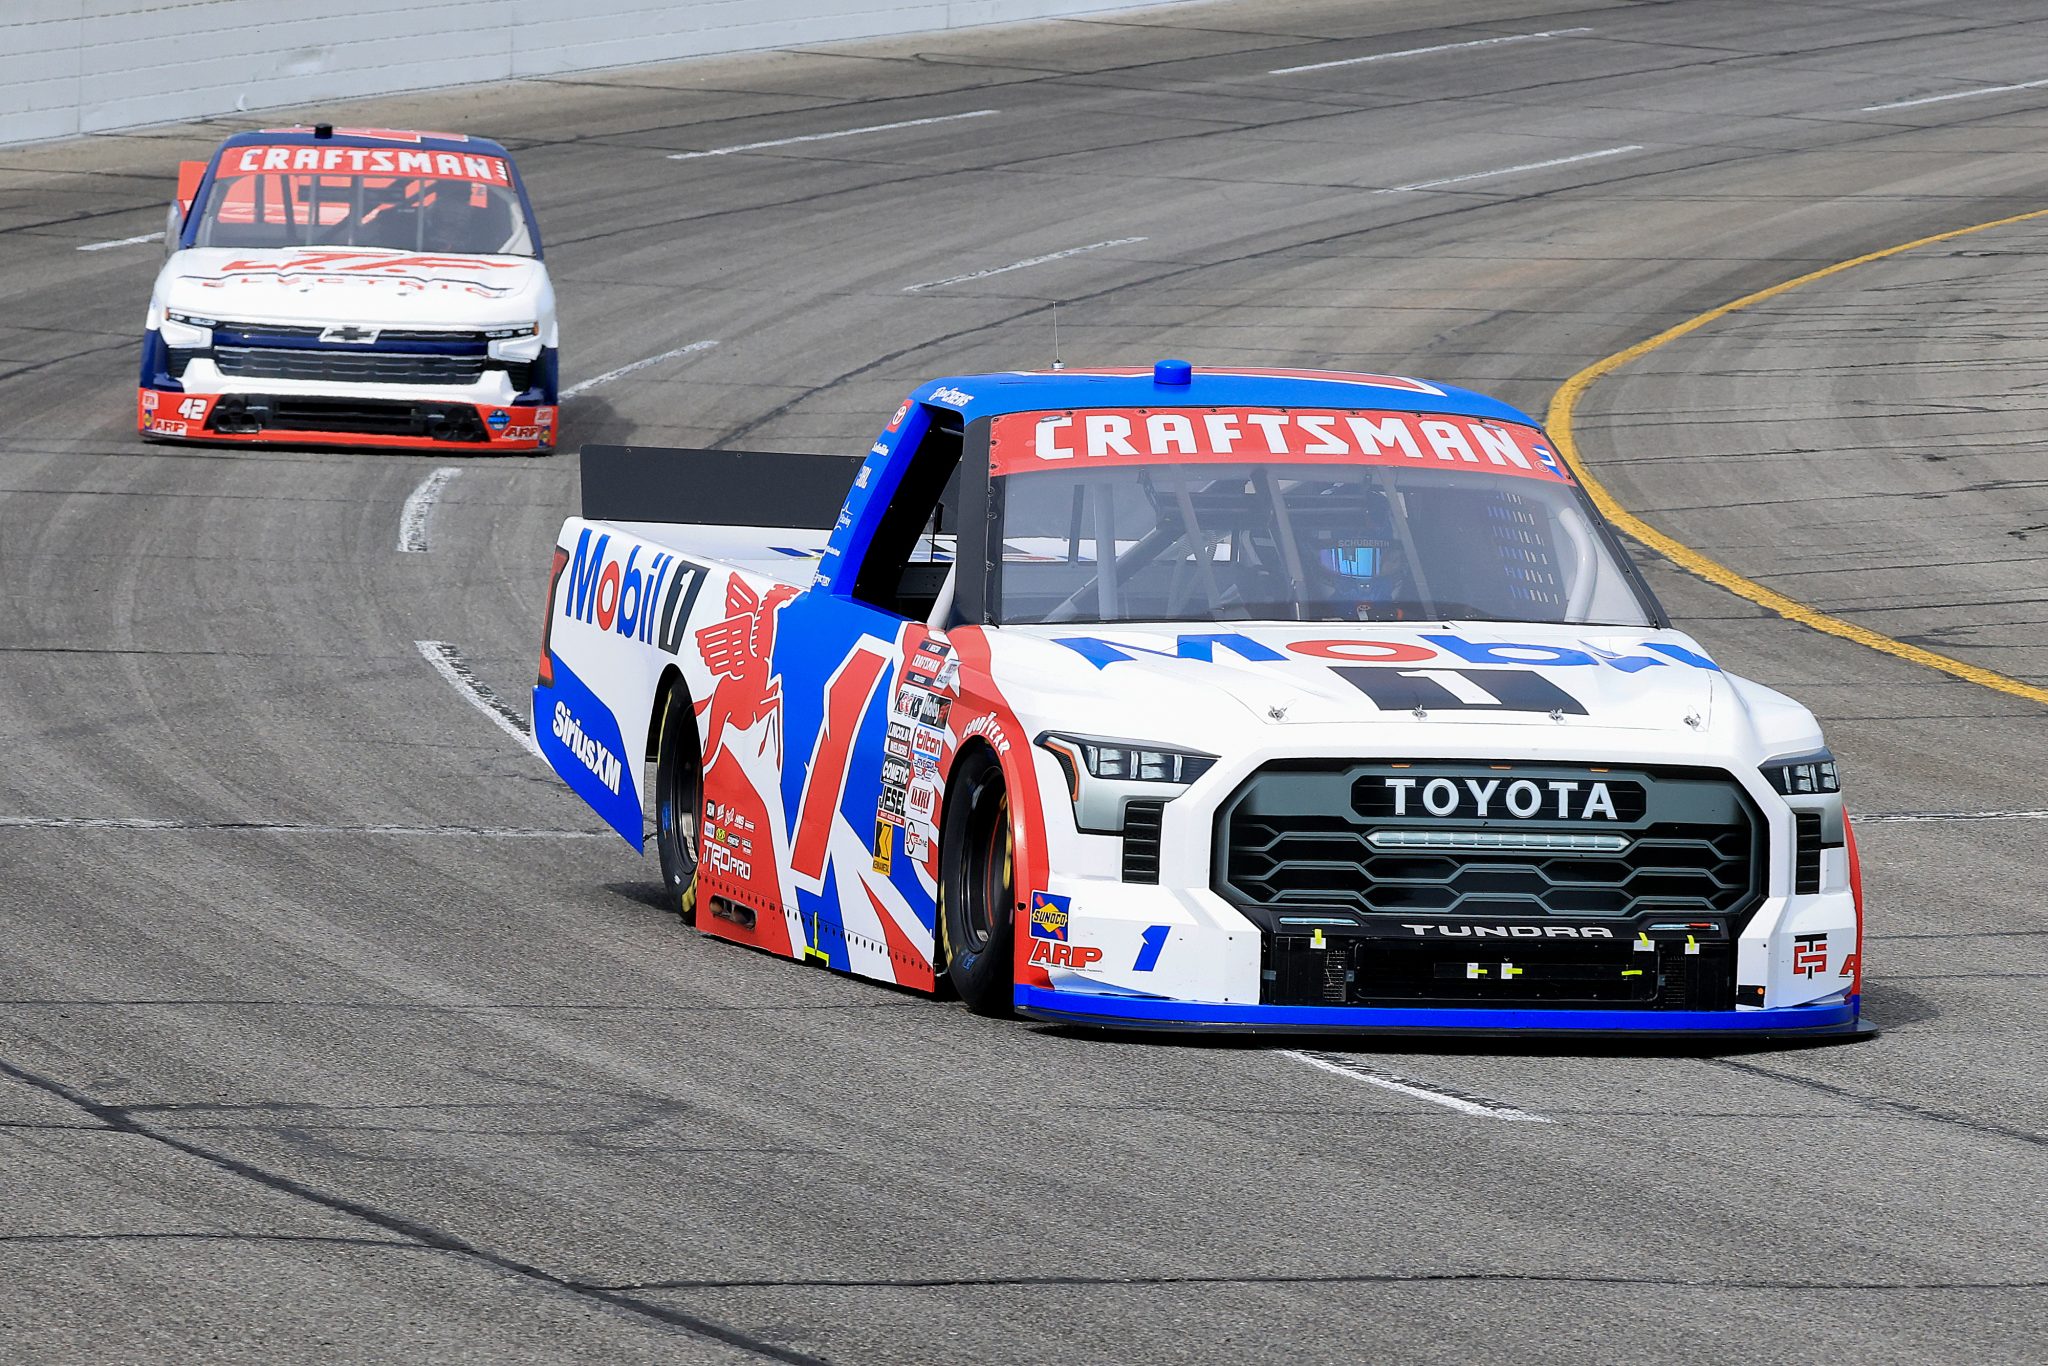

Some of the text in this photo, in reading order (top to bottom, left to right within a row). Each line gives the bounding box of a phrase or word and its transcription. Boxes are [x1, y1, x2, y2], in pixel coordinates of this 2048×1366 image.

[239, 149, 492, 180] CRAFTSMAN
[177, 398, 208, 420] 42
[155, 420, 186, 433] ARP
[1034, 414, 1533, 471] CRAFTSMAN
[1338, 538, 1390, 548] SCHUBERTH
[566, 527, 674, 646] Mobil
[911, 653, 942, 674] CRAFTSMAN
[1053, 632, 1723, 671] Mobil
[888, 722, 911, 742] LINCOLN
[962, 711, 1010, 756] GOODYEAR
[552, 700, 623, 797] SiriusXM
[882, 760, 909, 784] COMETIC
[878, 785, 907, 817] JESEL
[1384, 777, 1620, 821] TOYOTA
[702, 839, 731, 876] TRD
[729, 856, 752, 881] PRO
[1033, 910, 1067, 926] SUNOCO
[1400, 923, 1614, 938] TUNDRA
[1031, 941, 1103, 968] ARP
[1132, 925, 1172, 972] 1
